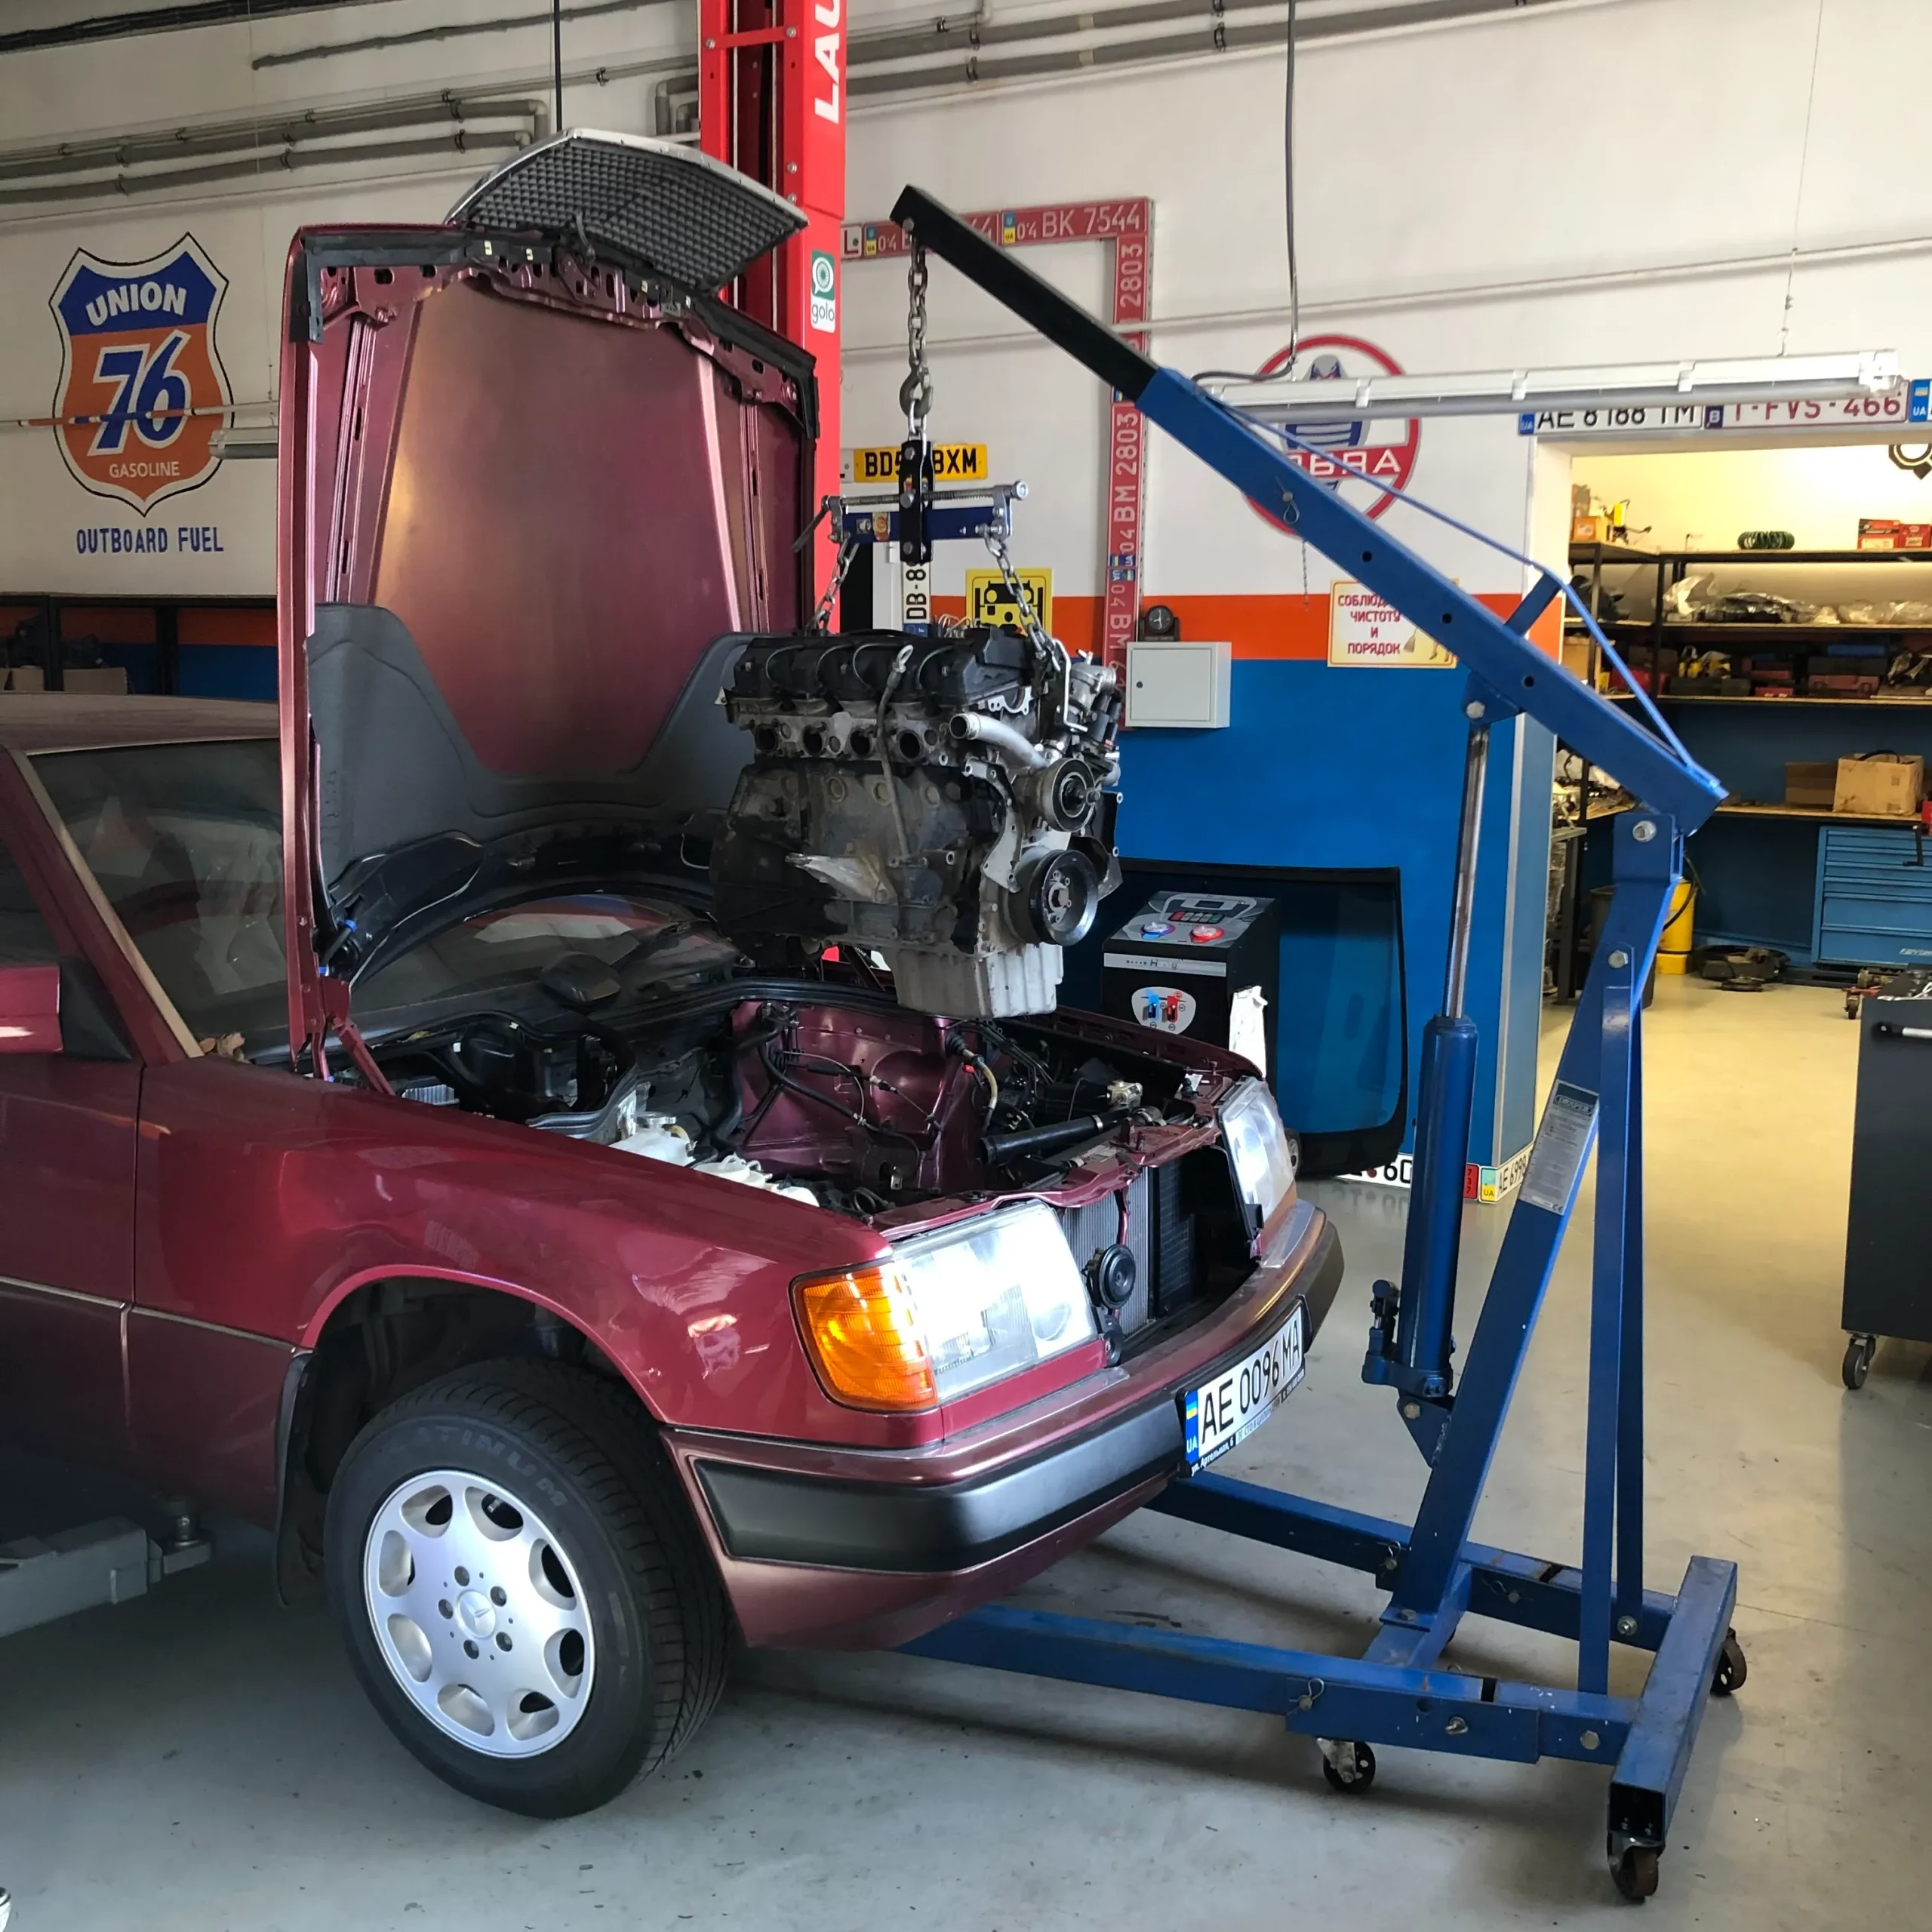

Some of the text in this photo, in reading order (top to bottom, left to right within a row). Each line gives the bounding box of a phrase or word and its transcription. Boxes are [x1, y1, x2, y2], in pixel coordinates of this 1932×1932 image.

[1042, 208, 1075, 238] BK
[1084, 202, 1140, 235] 7544
[1120, 244, 1143, 308] 2803
[86, 281, 188, 326] UNION
[812, 299, 835, 324] golo
[87, 329, 191, 457] 76
[1913, 406, 1927, 416] UA
[109, 461, 180, 478] GASOLINE
[1113, 412, 1139, 554] 2803 BM 04
[77, 527, 224, 554] OUTBOARD FUEL
[1110, 584, 1126, 607] 04
[1350, 611, 1401, 623] ЧИСТОТУ
[1109, 614, 1131, 650] BM
[1371, 627, 1378, 638] И
[1347, 642, 1400, 656] ПОРЯДОК
[1201, 1377, 1234, 1444] AE
[1240, 1340, 1279, 1414] 0096
[1281, 1319, 1300, 1378] MA
[1186, 1435, 1198, 1454] UA
